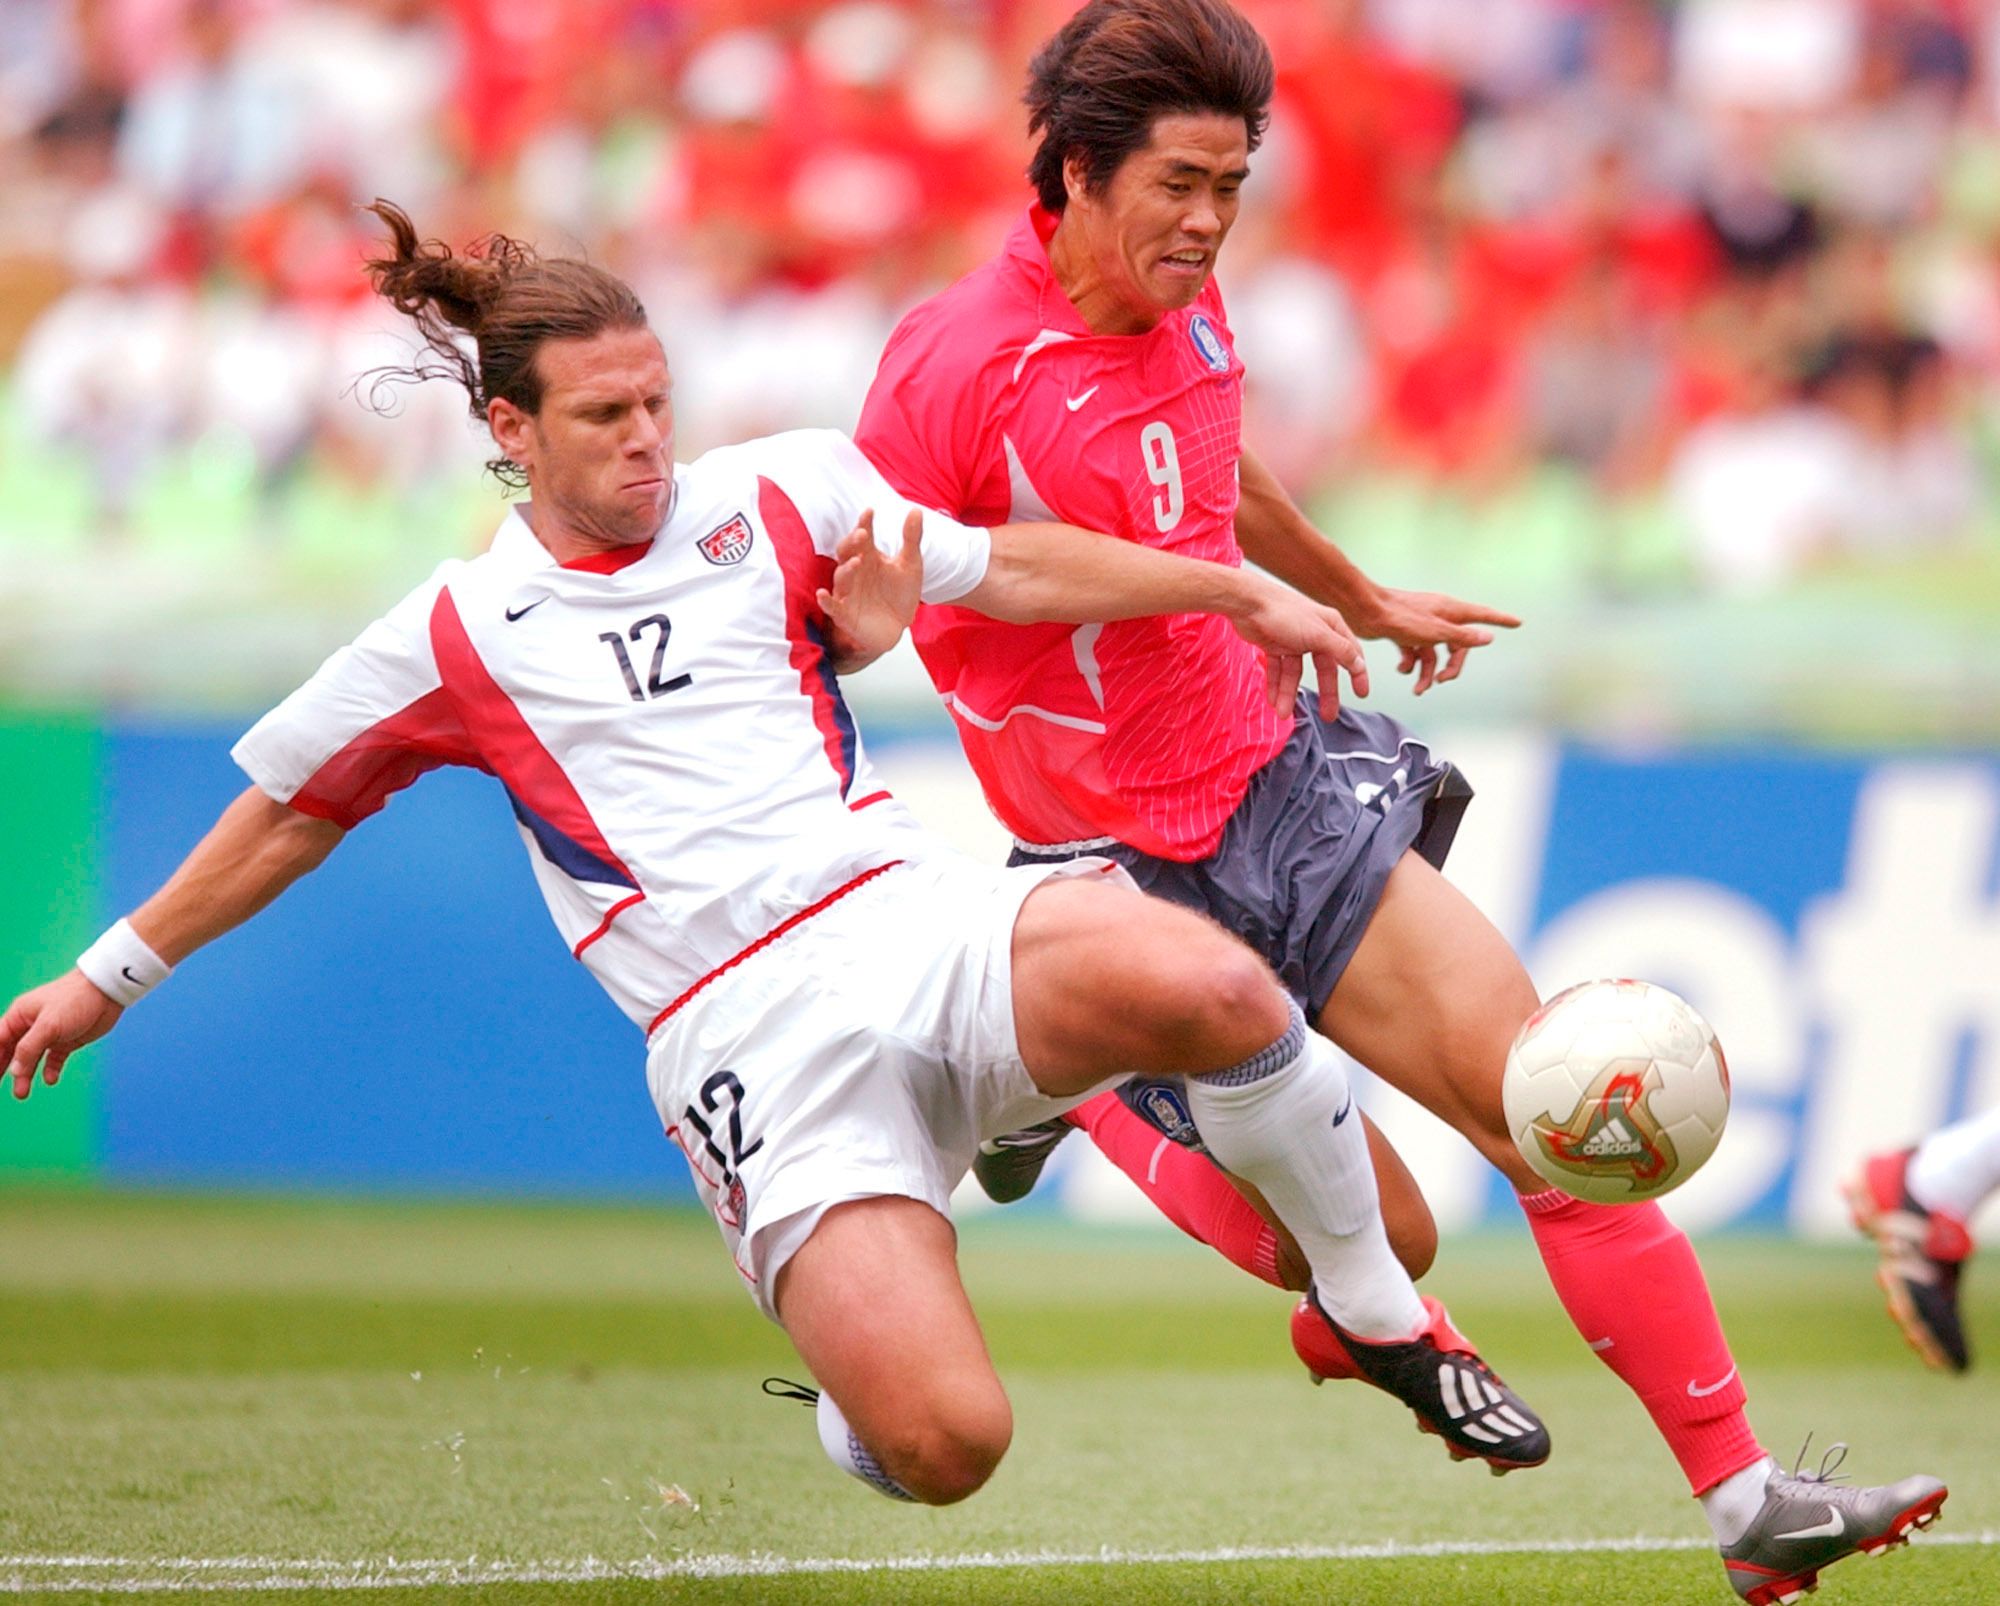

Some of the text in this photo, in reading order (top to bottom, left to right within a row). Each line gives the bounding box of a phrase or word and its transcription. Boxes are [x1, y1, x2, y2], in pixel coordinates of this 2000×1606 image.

[1140, 421, 1184, 533] 9
[598, 613, 693, 702] 12
[683, 1070, 765, 1186] 12
[1583, 1139, 1641, 1156] adidas
